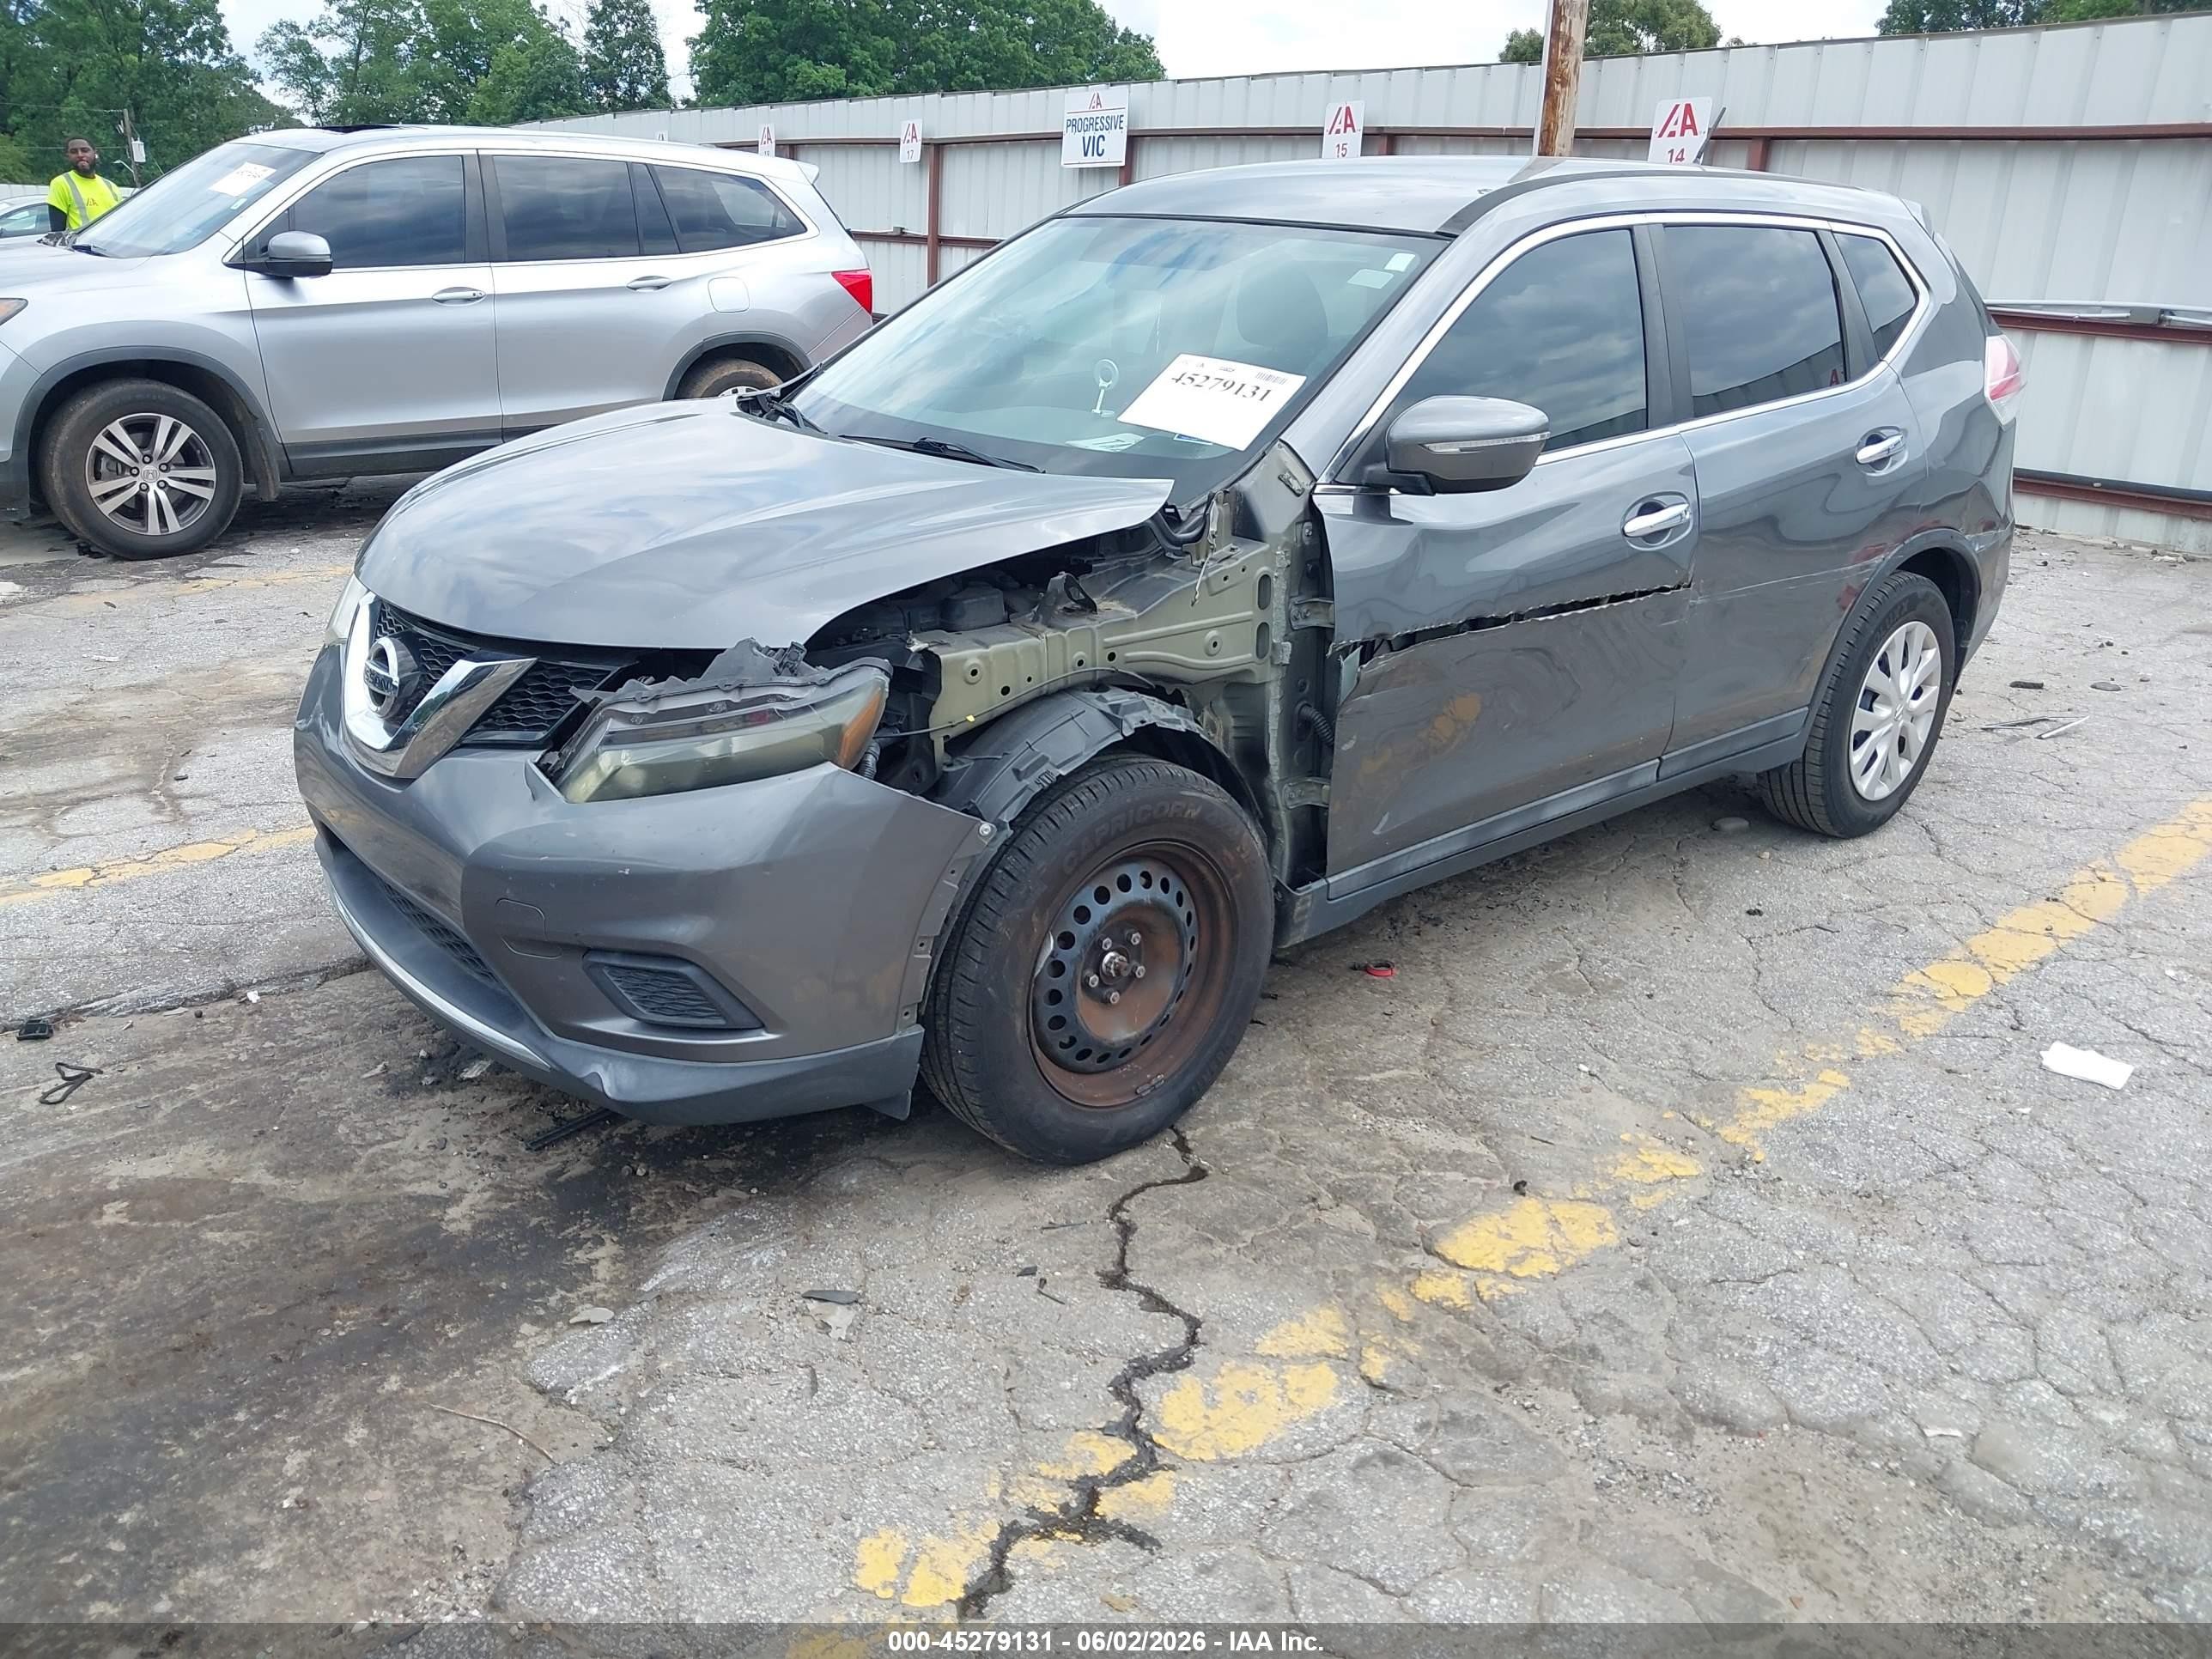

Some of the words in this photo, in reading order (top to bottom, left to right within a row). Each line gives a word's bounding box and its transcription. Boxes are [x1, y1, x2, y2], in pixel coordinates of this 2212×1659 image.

[1066, 114, 1124, 134] PROGRESSIVE
[1082, 134, 1106, 157] VIC
[1335, 143, 1348, 158] 15
[1668, 148, 1685, 163] 14
[1171, 372, 1273, 402] 45279131
[1060, 800, 1203, 875] CAPRICORN
